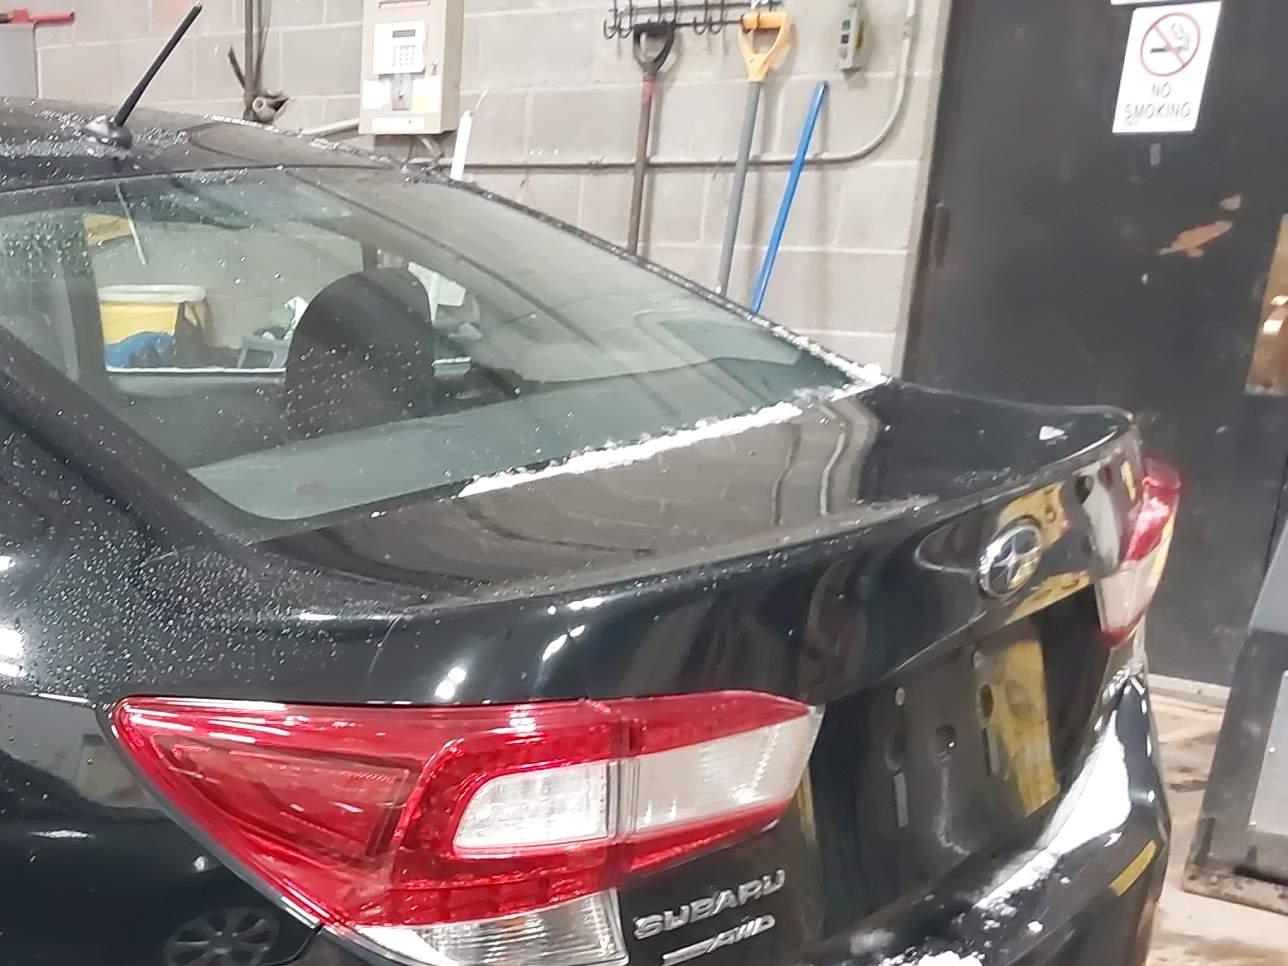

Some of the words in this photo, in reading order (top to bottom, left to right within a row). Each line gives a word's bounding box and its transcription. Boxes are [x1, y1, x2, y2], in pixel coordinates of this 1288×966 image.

[1150, 81, 1172, 98] NO
[1124, 102, 1191, 120] SMOKING
[633, 869, 785, 940] SUBARU
[708, 914, 776, 953] AWD
